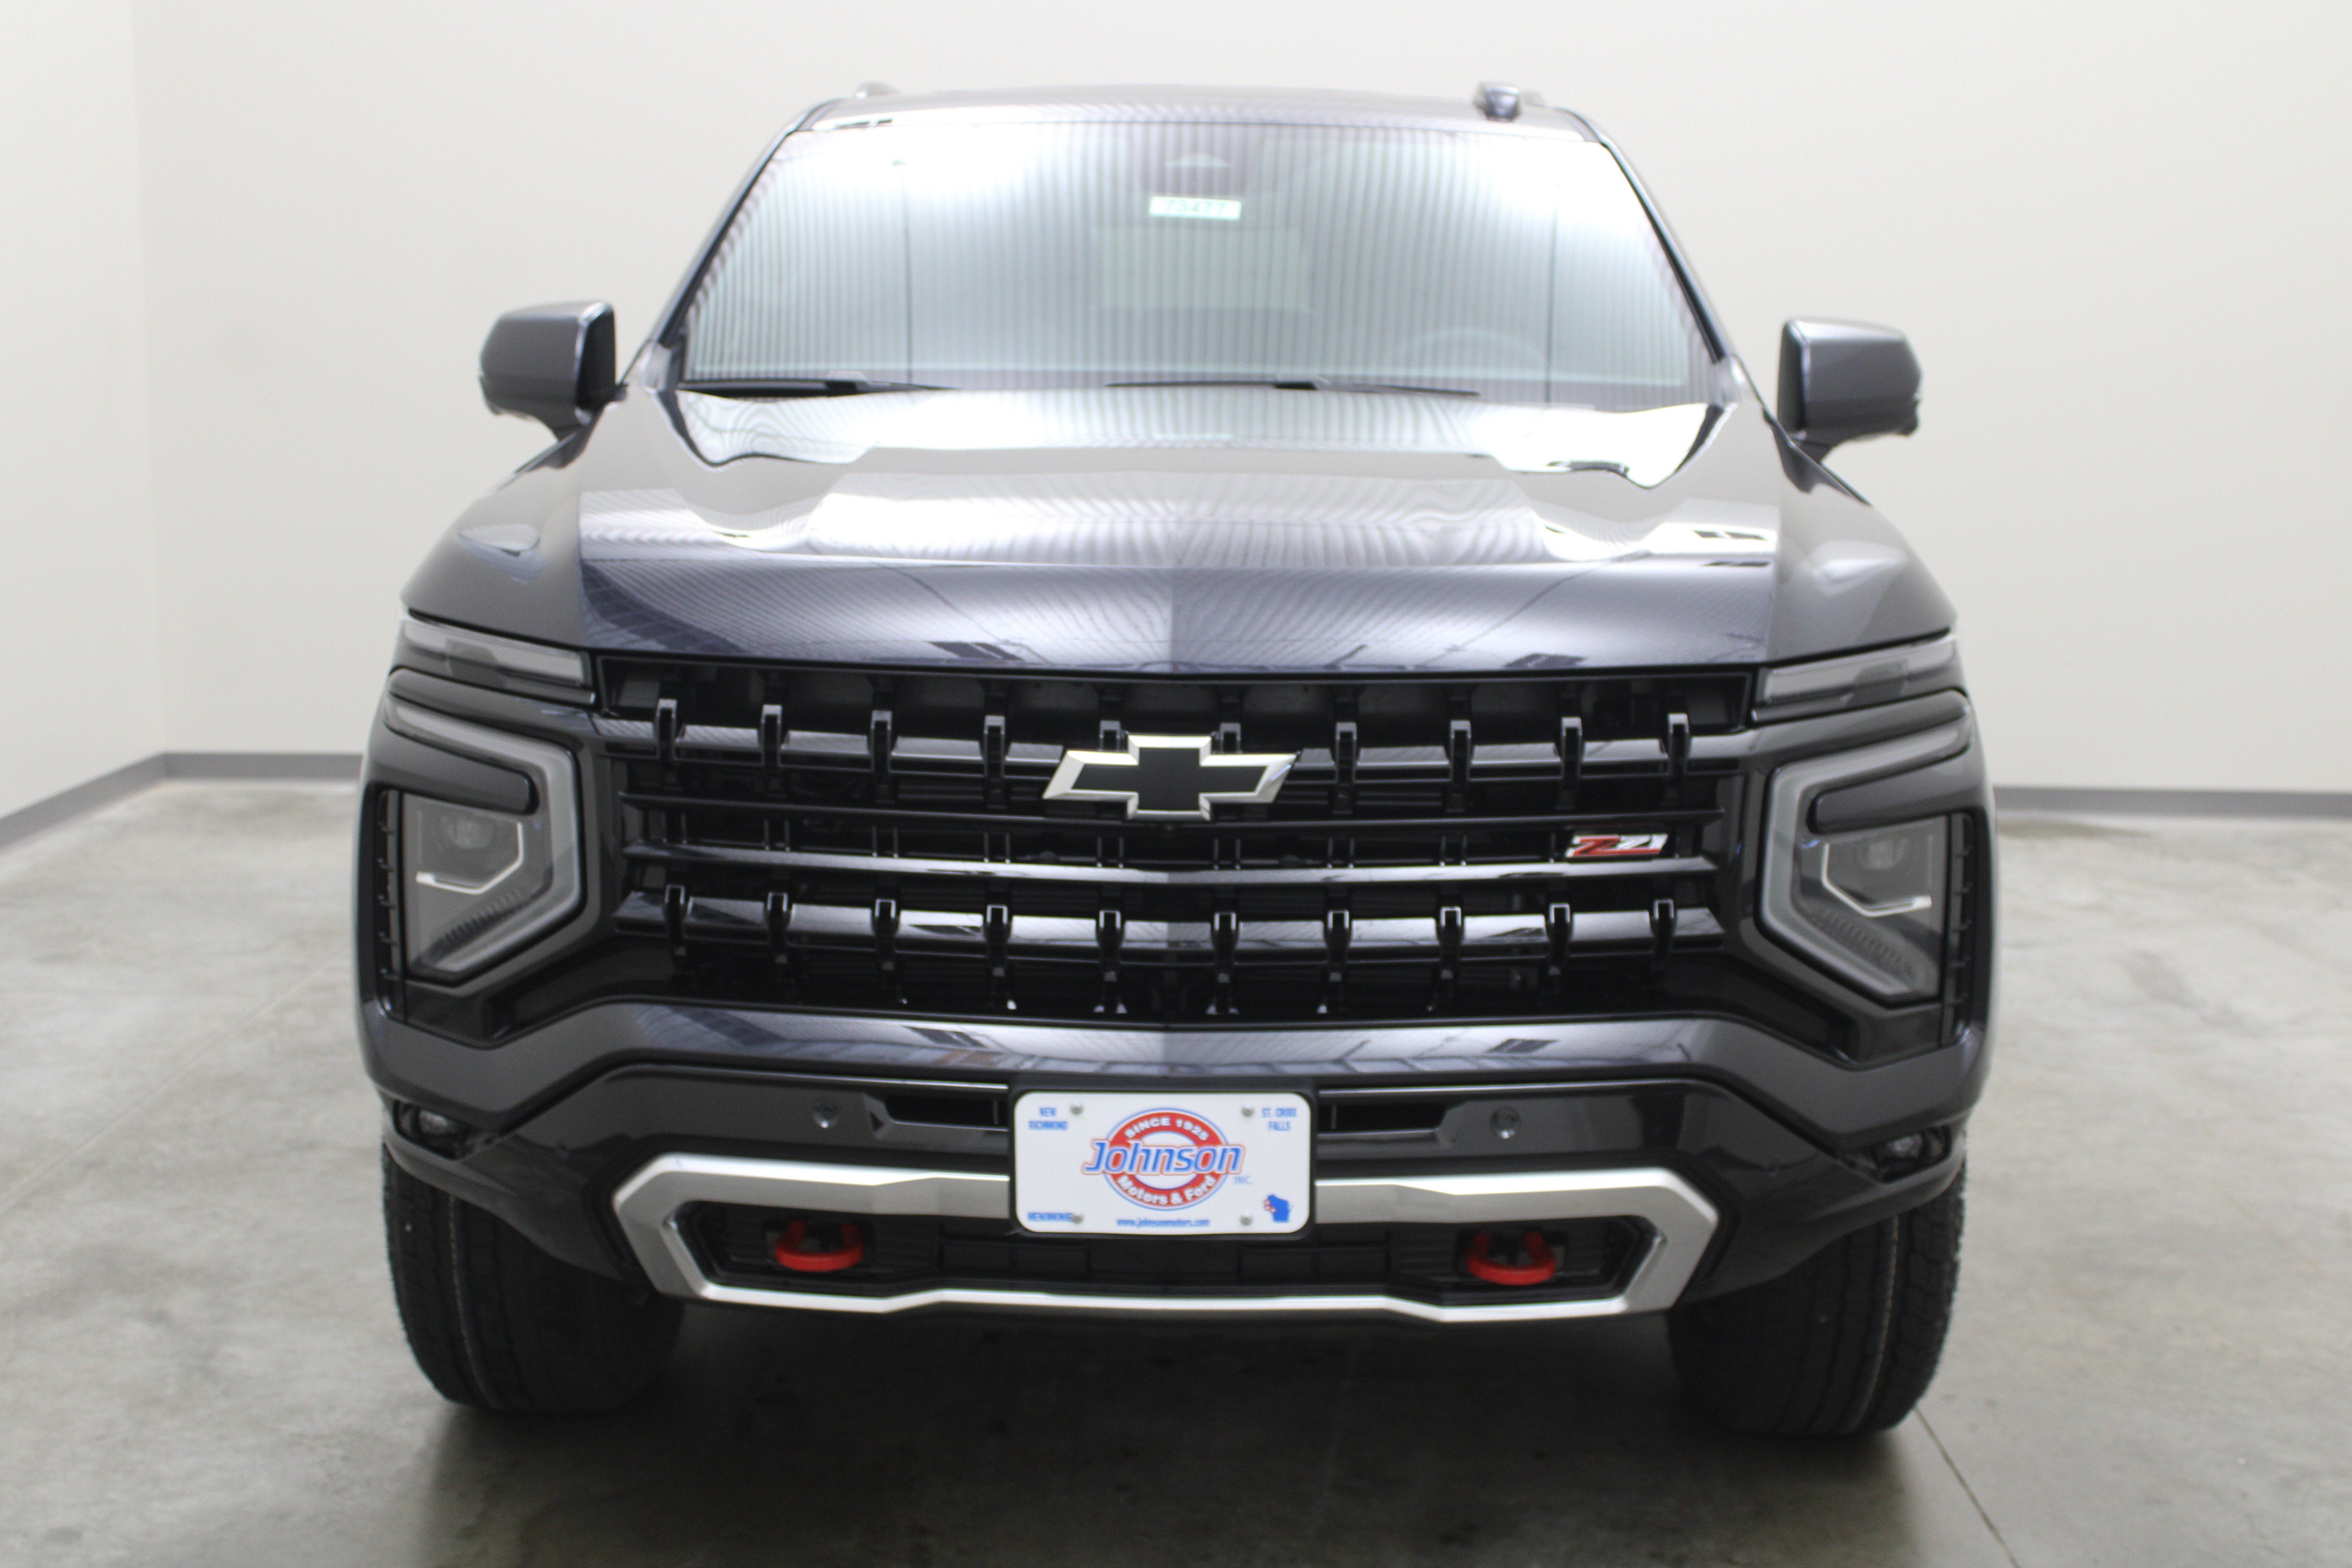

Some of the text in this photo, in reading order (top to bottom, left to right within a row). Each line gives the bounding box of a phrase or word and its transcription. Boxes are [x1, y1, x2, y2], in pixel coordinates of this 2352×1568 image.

[1040, 1107, 1056, 1116] NEW
[1124, 1117, 1171, 1139] SINCE
[1269, 1121, 1291, 1131] FALLS
[1082, 1139, 1244, 1175] Johnson
[1117, 1175, 1216, 1205] Motors & Ford
